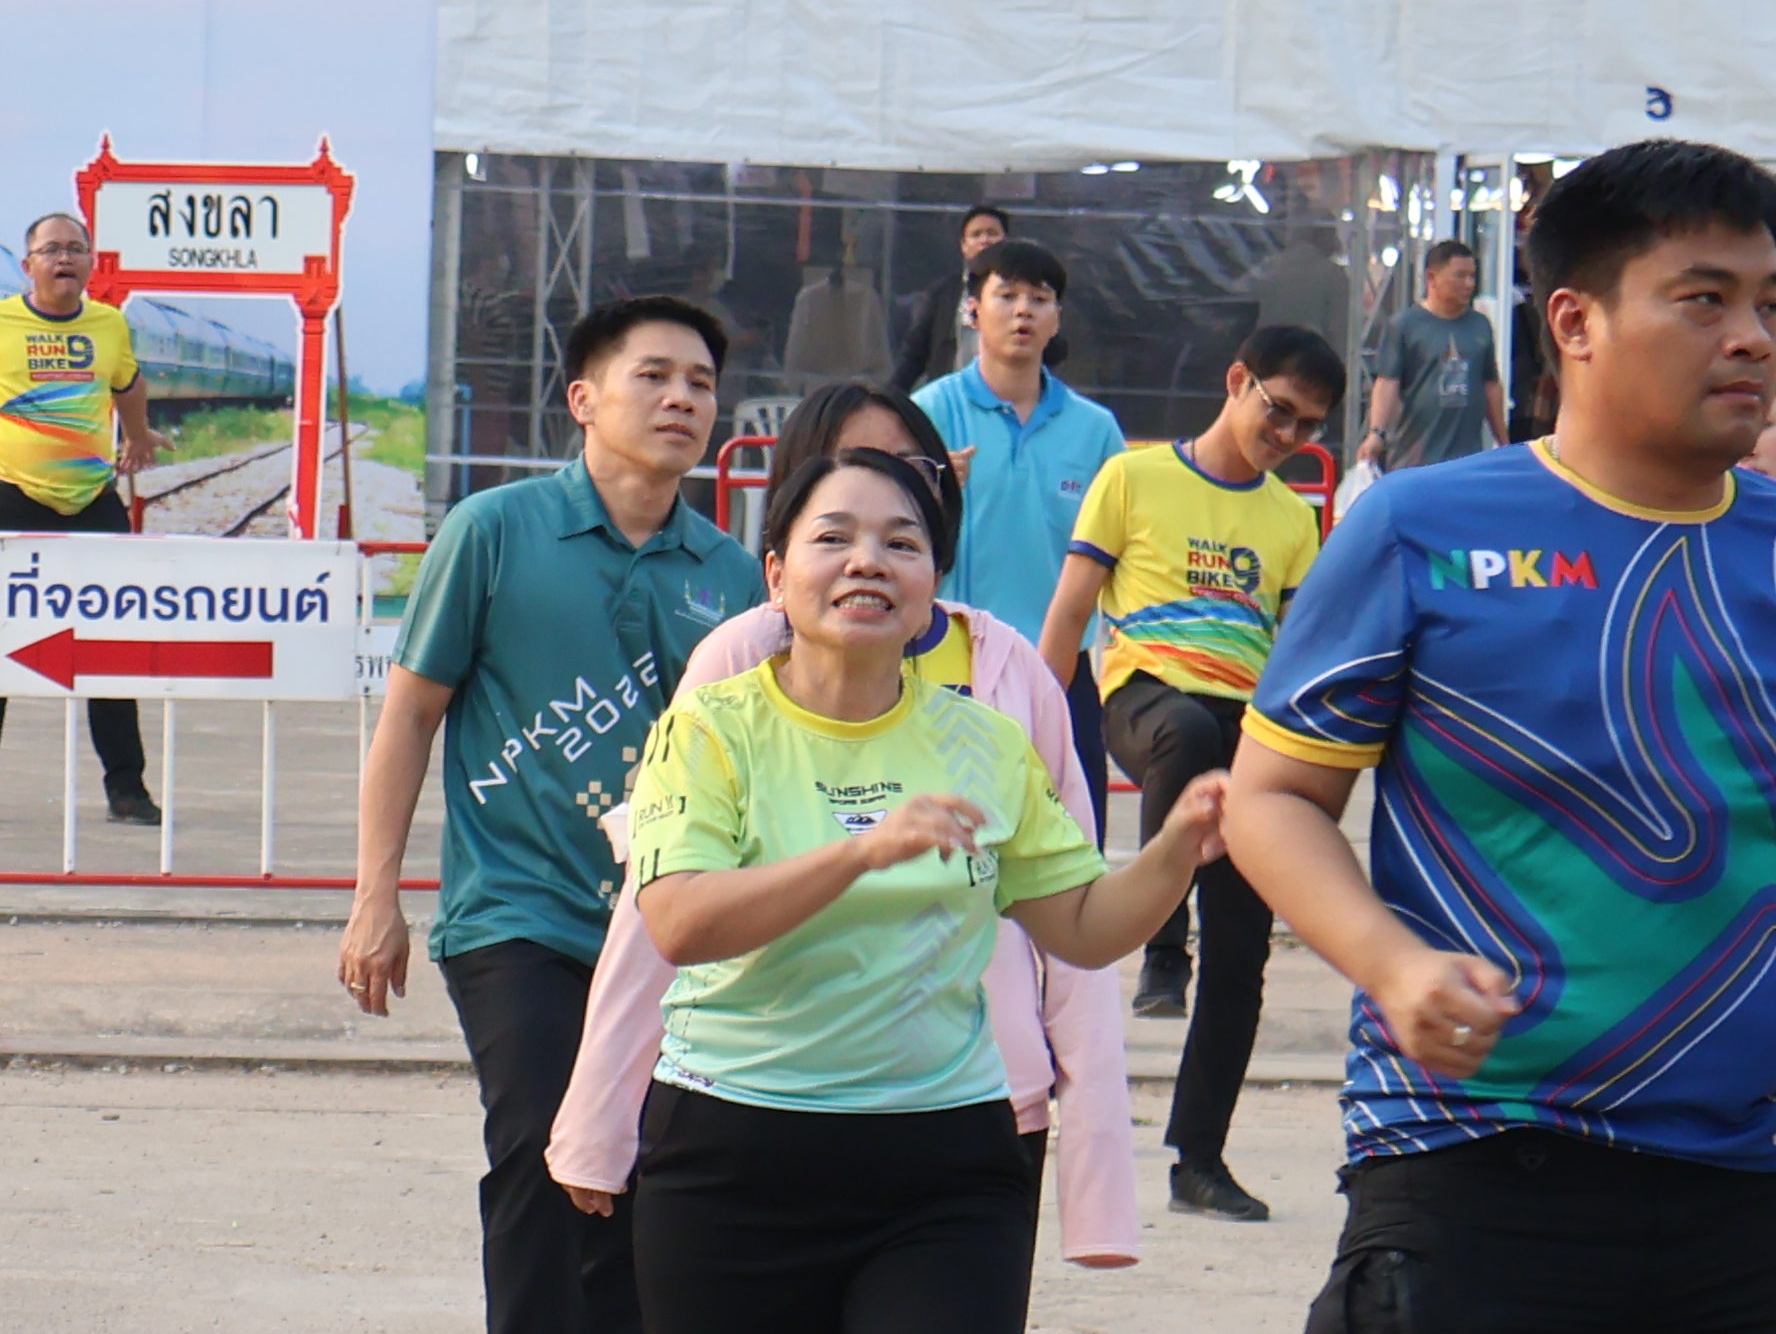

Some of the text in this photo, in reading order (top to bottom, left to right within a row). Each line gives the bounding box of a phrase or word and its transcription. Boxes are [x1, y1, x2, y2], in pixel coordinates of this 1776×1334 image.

[148, 188, 279, 239] สงขลา
[168, 247, 258, 269] SONGKHLA
[26, 344, 66, 357] RUN
[28, 358, 67, 370] BIKE
[67, 334, 94, 370] 9
[1187, 551, 1232, 570] RUN
[1231, 546, 1261, 594] 9
[1428, 549, 1599, 590] NPKM
[6, 551, 331, 624] ที่จอดรถยนต์
[1187, 570, 1235, 587] BIKE
[468, 675, 598, 805] NPKM
[815, 781, 903, 796] SUNSHINE
